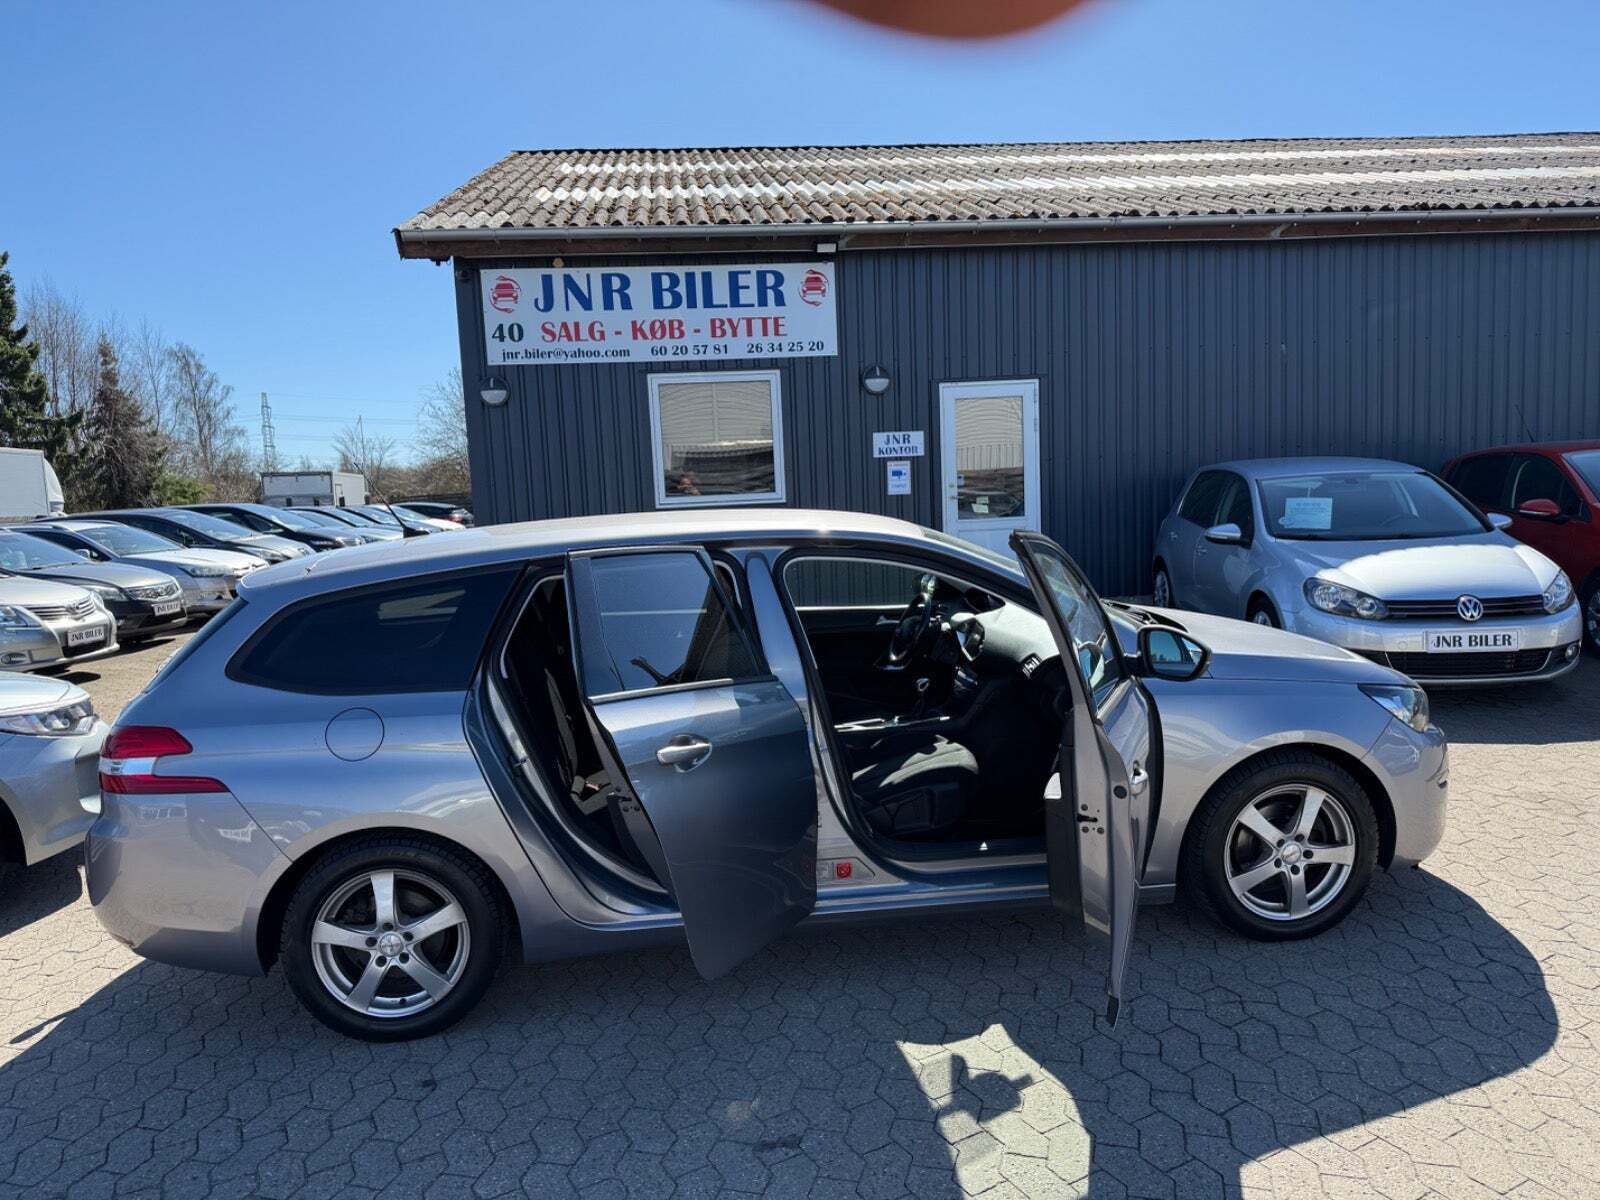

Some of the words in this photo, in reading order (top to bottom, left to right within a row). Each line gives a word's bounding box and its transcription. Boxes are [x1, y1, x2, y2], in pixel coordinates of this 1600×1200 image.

[534, 272, 633, 312] JNR
[651, 269, 786, 310] BILER
[492, 323, 524, 342] 40
[541, 320, 606, 343] SALG
[631, 317, 685, 341] KØB
[710, 316, 788, 339] BYTTE
[650, 345, 667, 356] 60
[672, 344, 688, 356] 20
[692, 344, 708, 355] 57
[713, 343, 728, 355] 81
[746, 342, 763, 354] 26
[767, 341, 783, 353] 34
[788, 341, 803, 353] 25
[808, 340, 824, 352] 20
[502, 347, 630, 362] jnr.biler@yahoo.com
[884, 433, 911, 445] JNR
[878, 445, 918, 456] KONTOR
[71, 631, 84, 642] JNR
[1433, 635, 1462, 648] JNR
[1468, 634, 1512, 647] BILER
